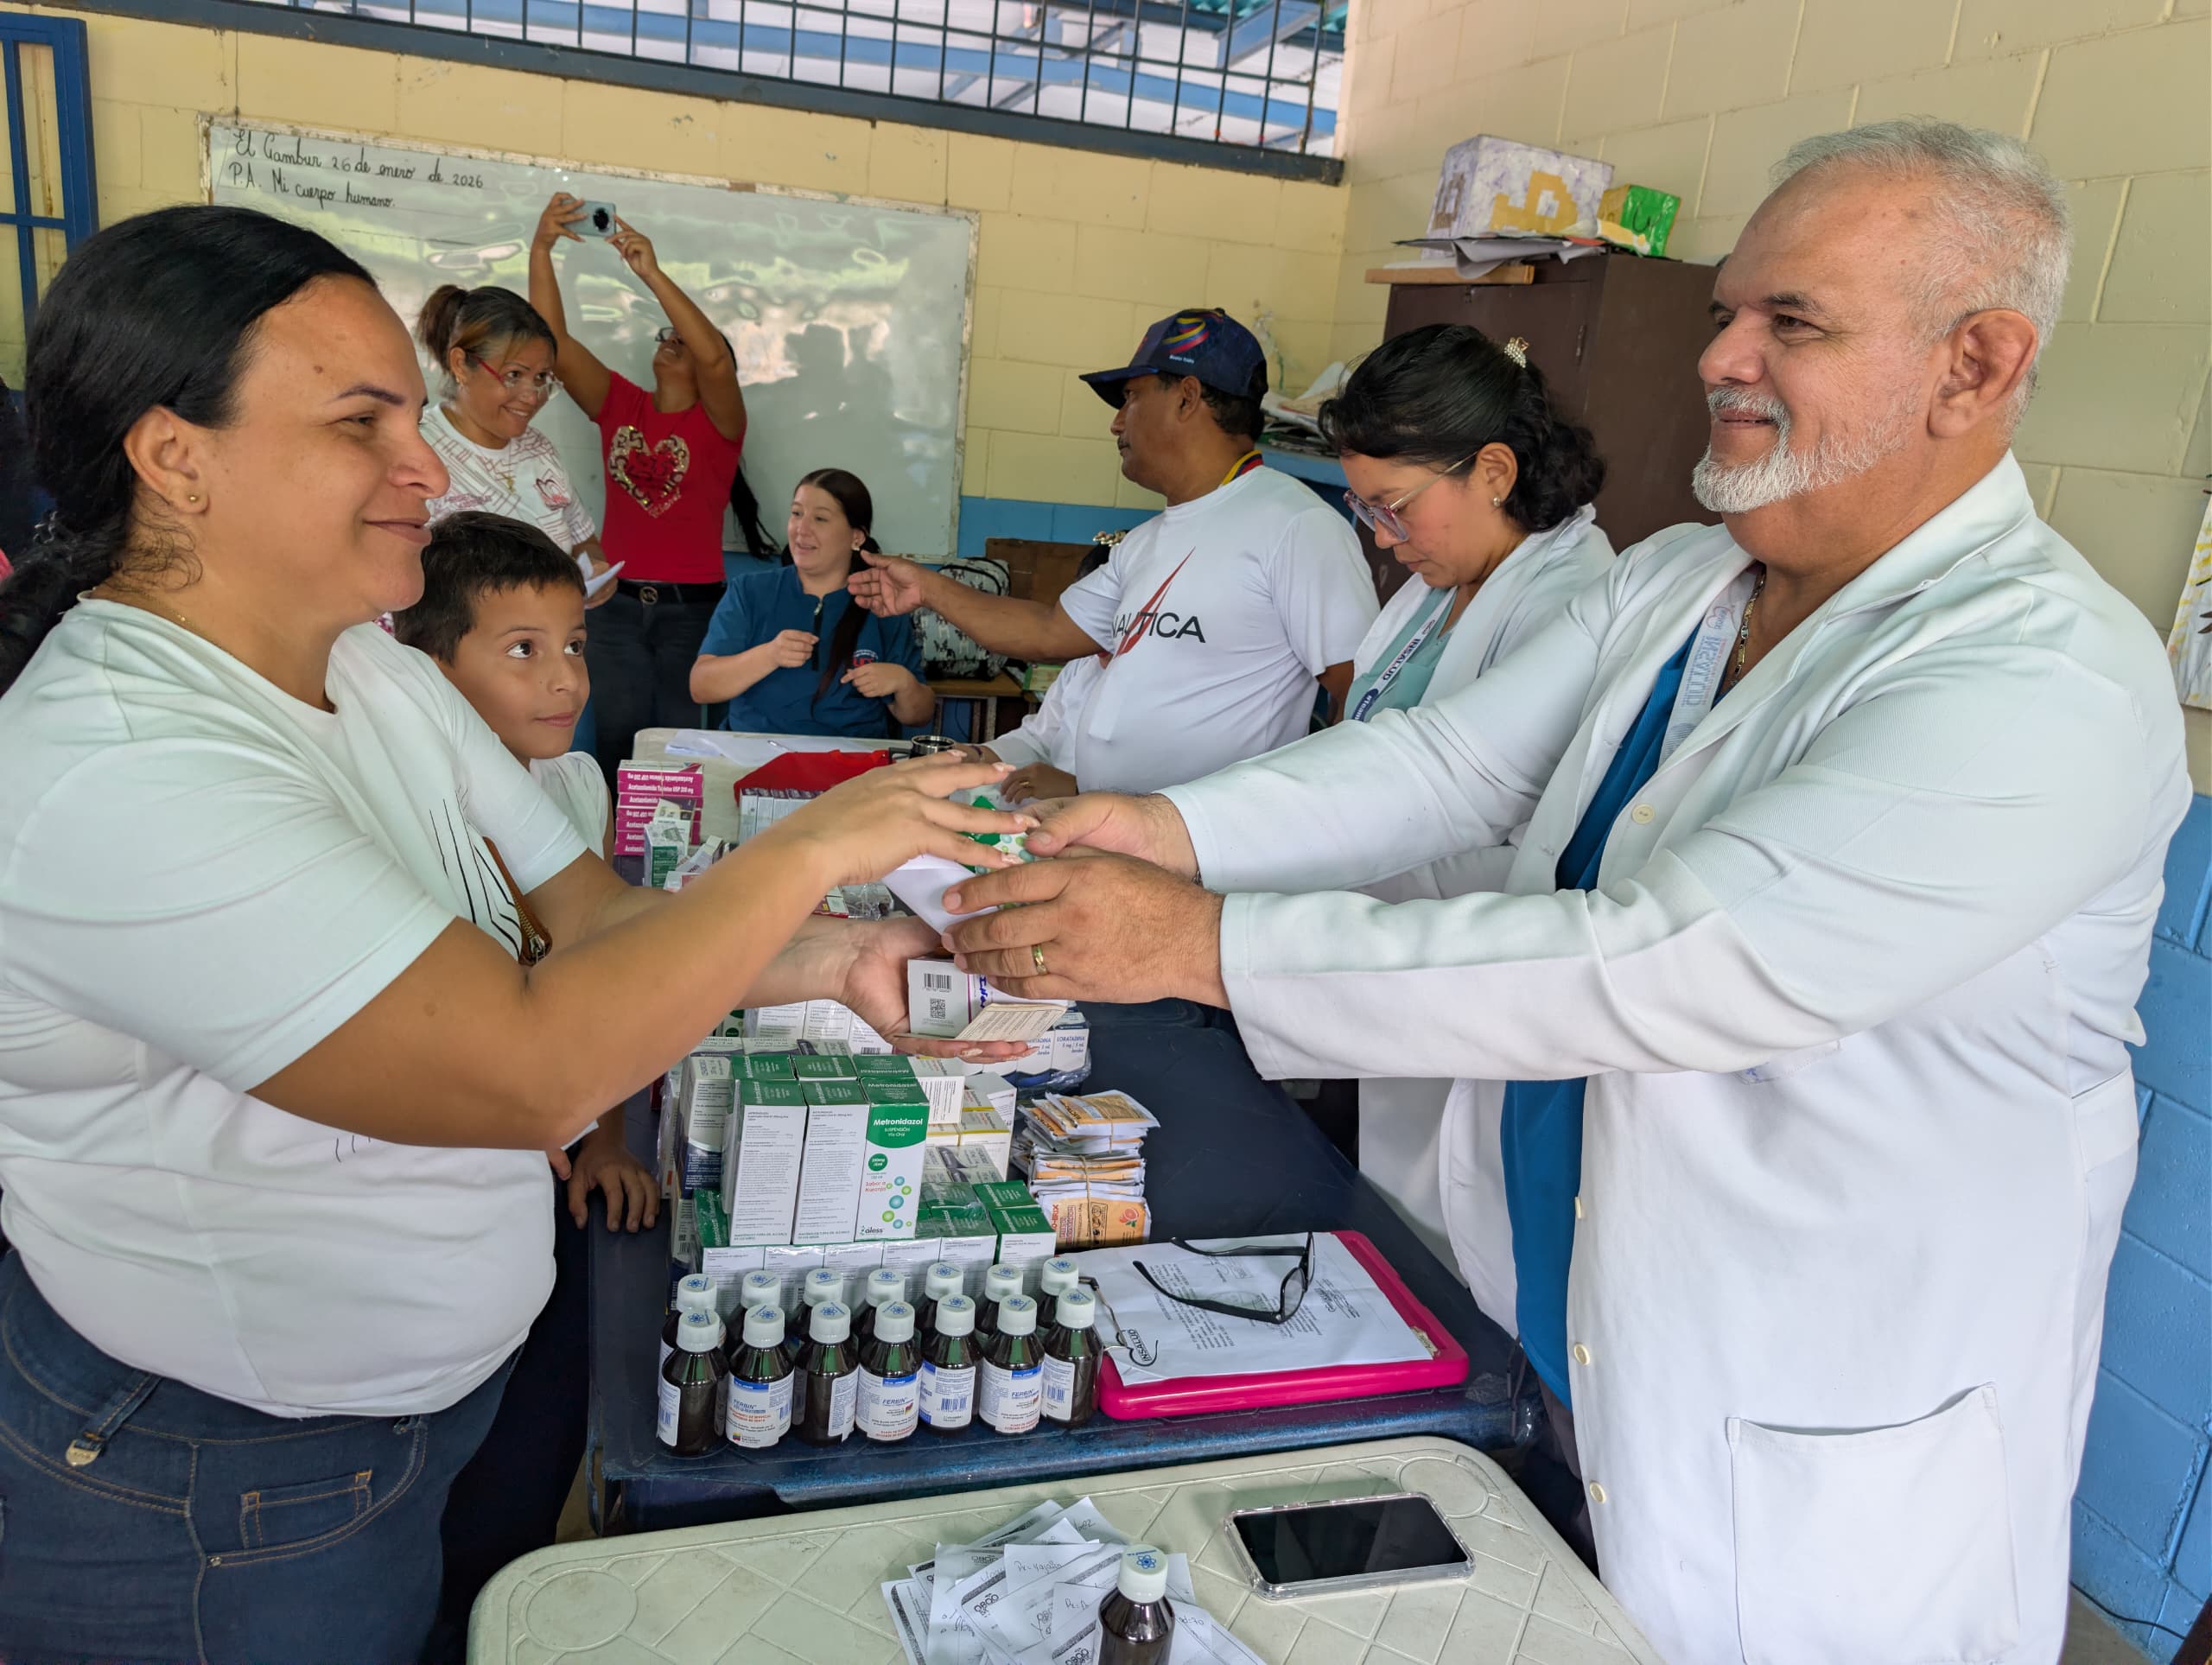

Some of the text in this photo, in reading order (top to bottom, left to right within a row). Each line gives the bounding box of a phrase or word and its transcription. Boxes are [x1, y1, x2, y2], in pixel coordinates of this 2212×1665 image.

[233, 129, 256, 157] El
[332, 156, 351, 172] 26
[354, 146, 371, 173] de
[374, 163, 416, 180] enero
[429, 156, 443, 182] de
[452, 173, 484, 188] 2026
[272, 167, 289, 193] Mi
[296, 183, 336, 210] cuerpo
[1112, 612, 1206, 644] NAUTICA
[1382, 639, 1421, 681] INSALUD
[1128, 1329, 1152, 1362] INSALUD
